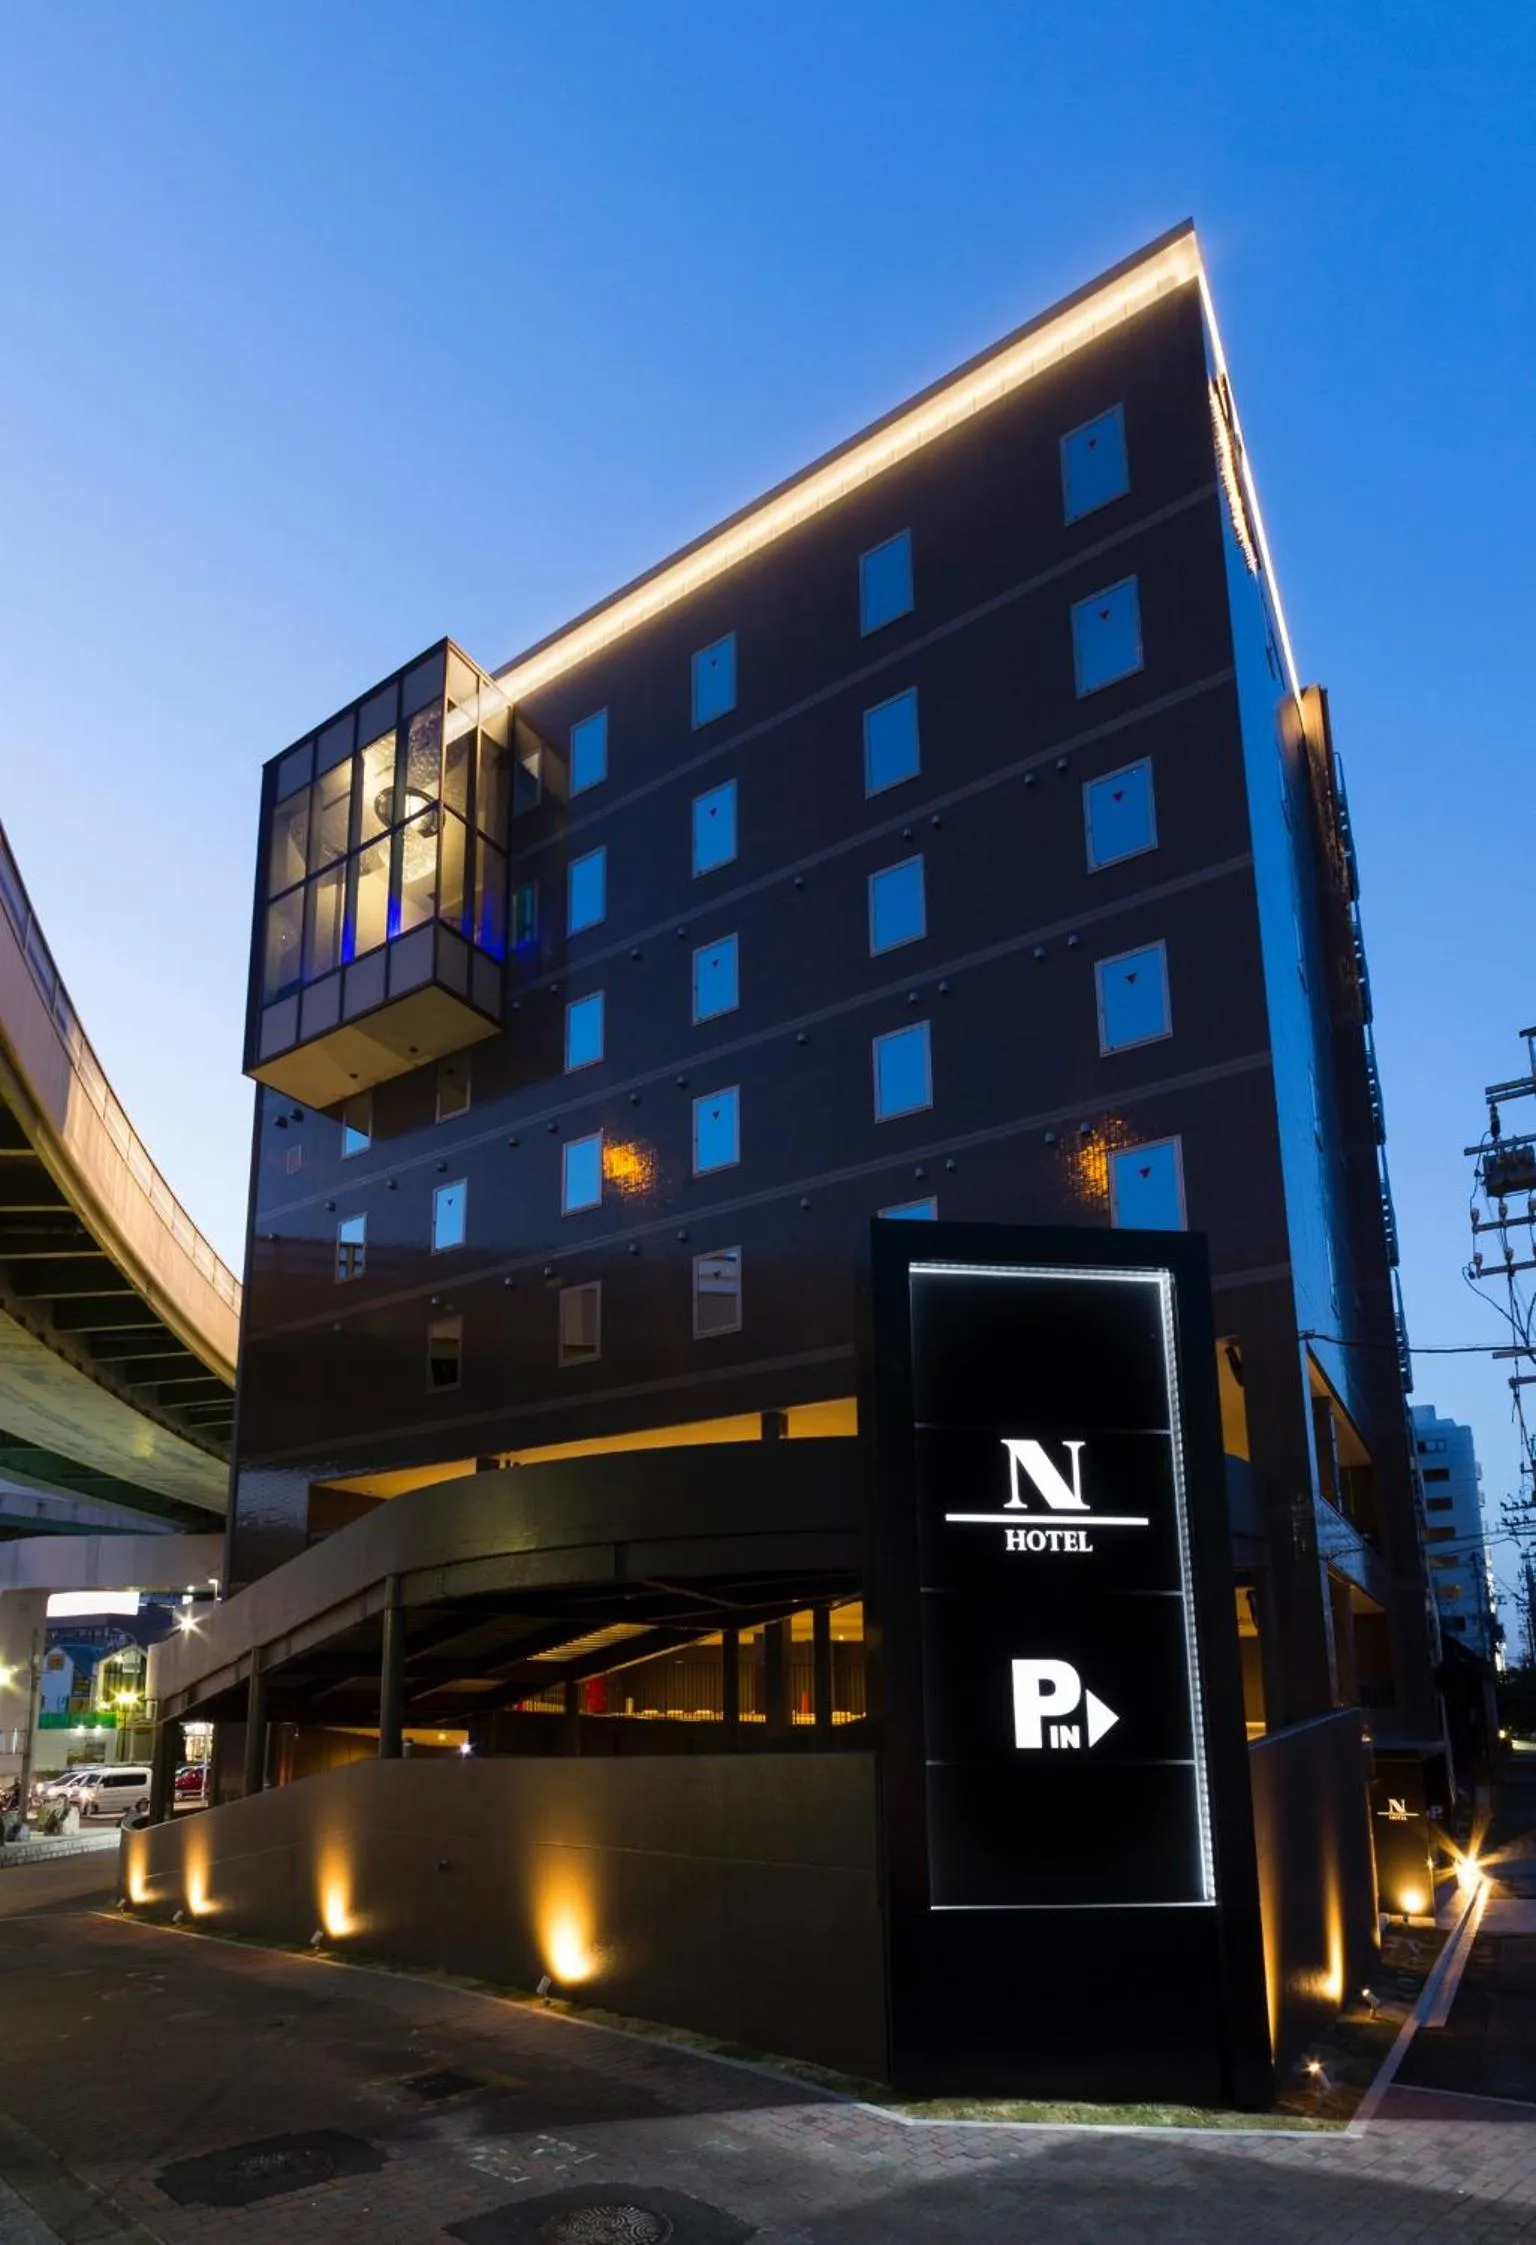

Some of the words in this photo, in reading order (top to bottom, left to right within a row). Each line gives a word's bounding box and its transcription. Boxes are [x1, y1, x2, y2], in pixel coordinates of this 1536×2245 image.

[1000, 1438, 1091, 1511] N
[1004, 1529, 1094, 1553] HOTEL
[1011, 1659, 1082, 1749] P
[1049, 1724, 1081, 1749] IN
[1388, 1798, 1407, 1814] N
